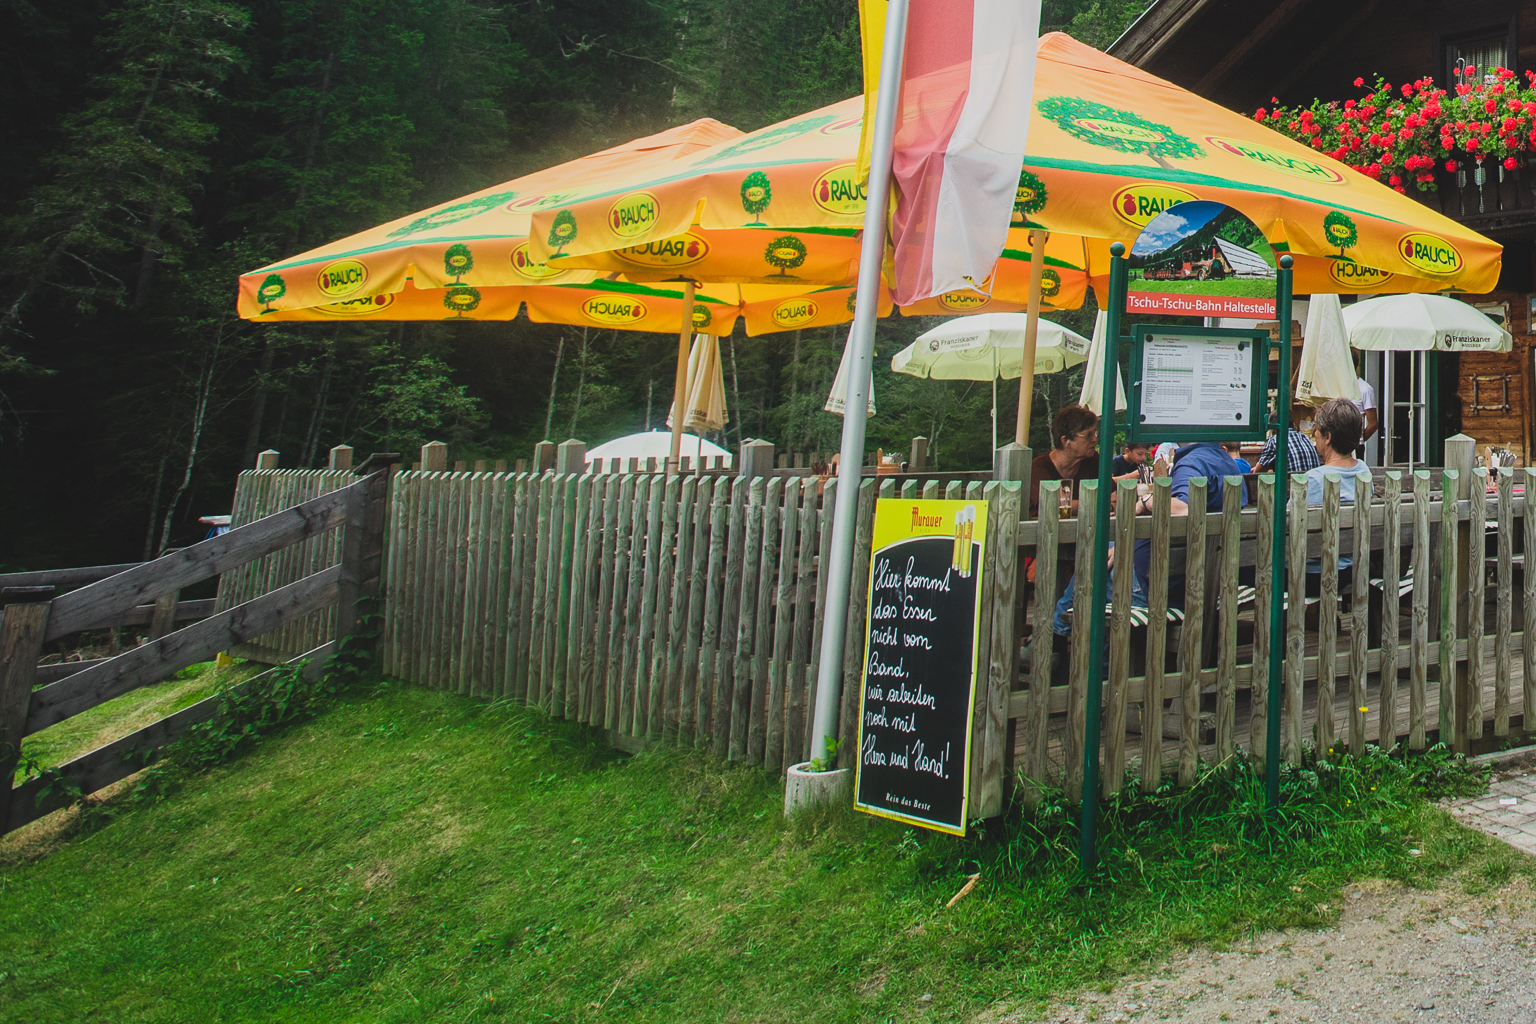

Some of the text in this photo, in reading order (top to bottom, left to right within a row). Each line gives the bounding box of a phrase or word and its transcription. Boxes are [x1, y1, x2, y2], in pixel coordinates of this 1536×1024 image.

[1243, 146, 1331, 178] RAUCH
[620, 202, 654, 226] RAUCH
[1414, 242, 1457, 267] RAUCH
[330, 267, 363, 287] RAUCH
[1128, 295, 1276, 314] Tschu-Tschu-Bahn Haltestelle
[941, 335, 979, 346] Franziskaner
[1452, 335, 1491, 343] Franziskaner
[911, 506, 943, 532] Murauer
[875, 555, 951, 597] Hier kommt
[872, 594, 938, 622] das Essen
[871, 626, 933, 651] nicht vom
[867, 682, 936, 710] wir arbeiten
[864, 706, 916, 733] noch mit
[862, 733, 950, 780] Herz und Hand!
[885, 792, 931, 811] Rein das Beste
